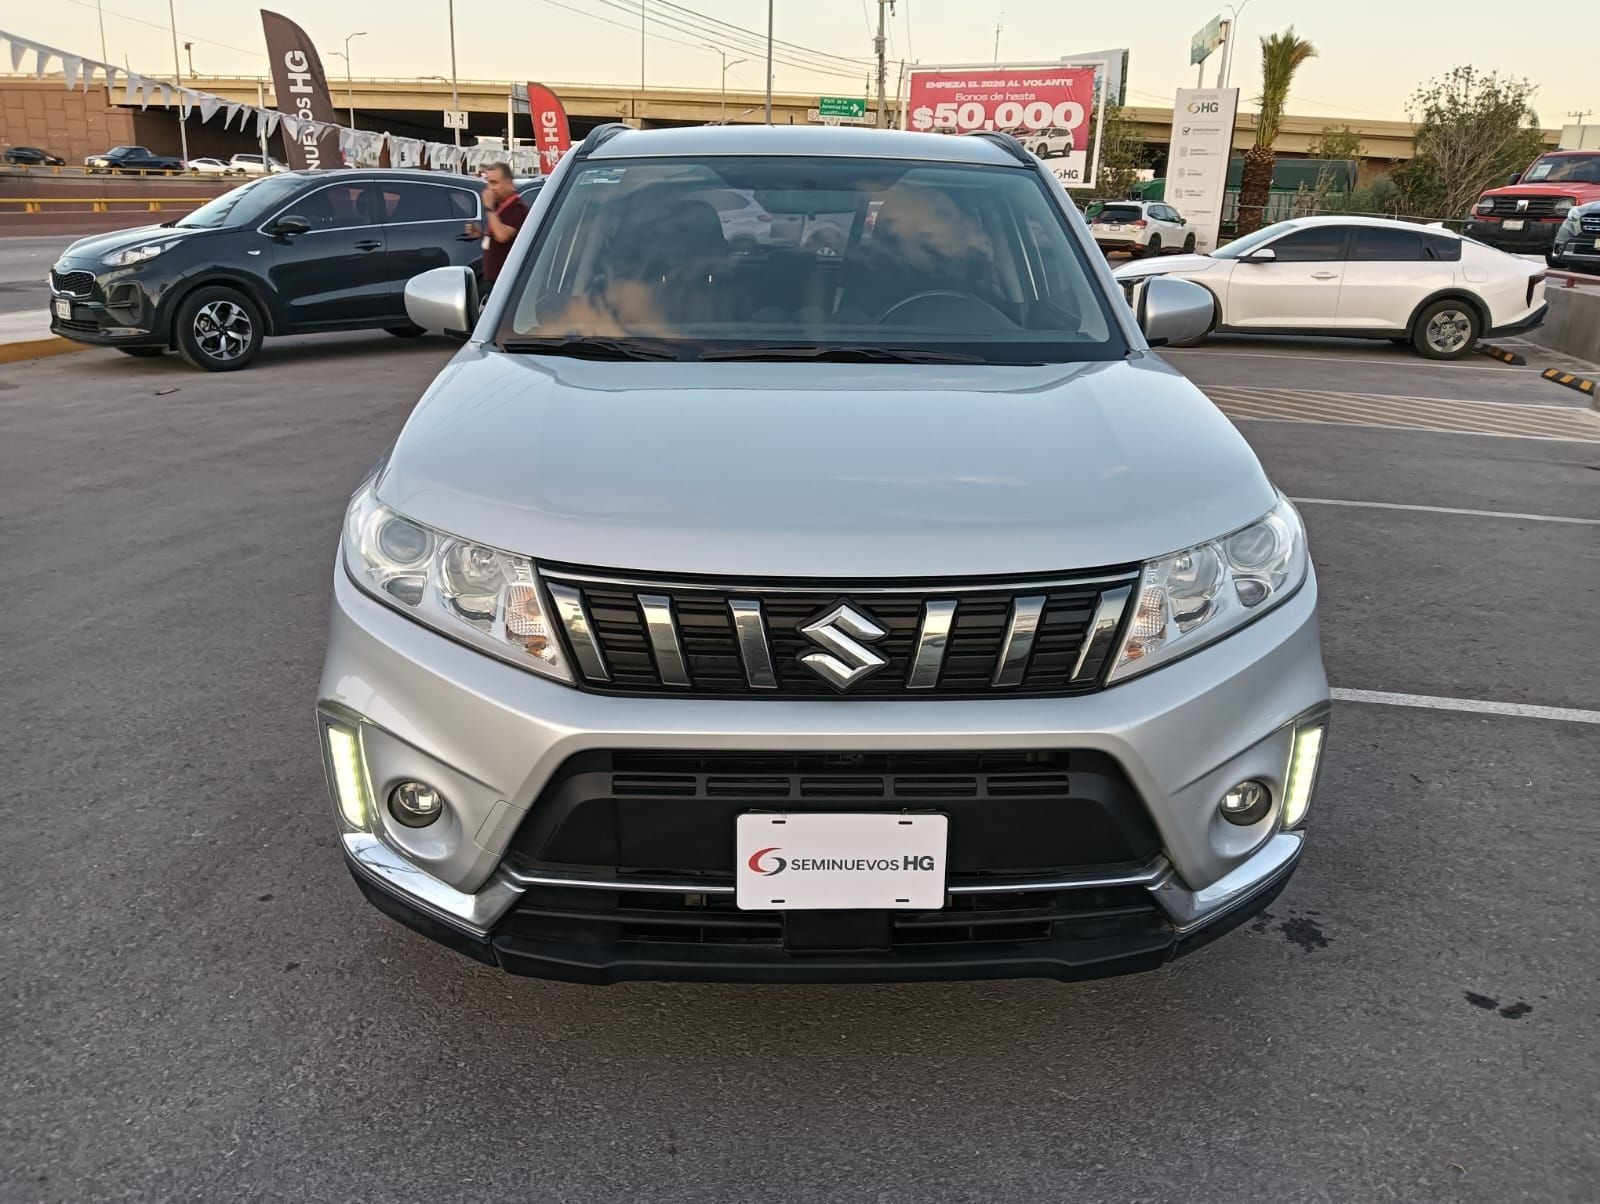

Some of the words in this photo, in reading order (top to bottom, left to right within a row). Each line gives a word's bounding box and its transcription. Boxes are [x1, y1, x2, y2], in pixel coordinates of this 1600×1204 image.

[284, 50, 314, 94] HG
[925, 81, 967, 89] EMPIEZA
[981, 80, 1006, 88] 2026
[1023, 78, 1074, 87] VOLANTE
[955, 93, 989, 101] Bonos
[990, 92, 1003, 101] de
[1005, 92, 1036, 101] hasta
[1200, 102, 1219, 113] HG
[912, 101, 1085, 132] $50,000
[541, 111, 559, 142] HG
[1063, 169, 1079, 180] HG
[790, 858, 900, 872] SEMINUEVOS
[903, 855, 935, 871] HG
